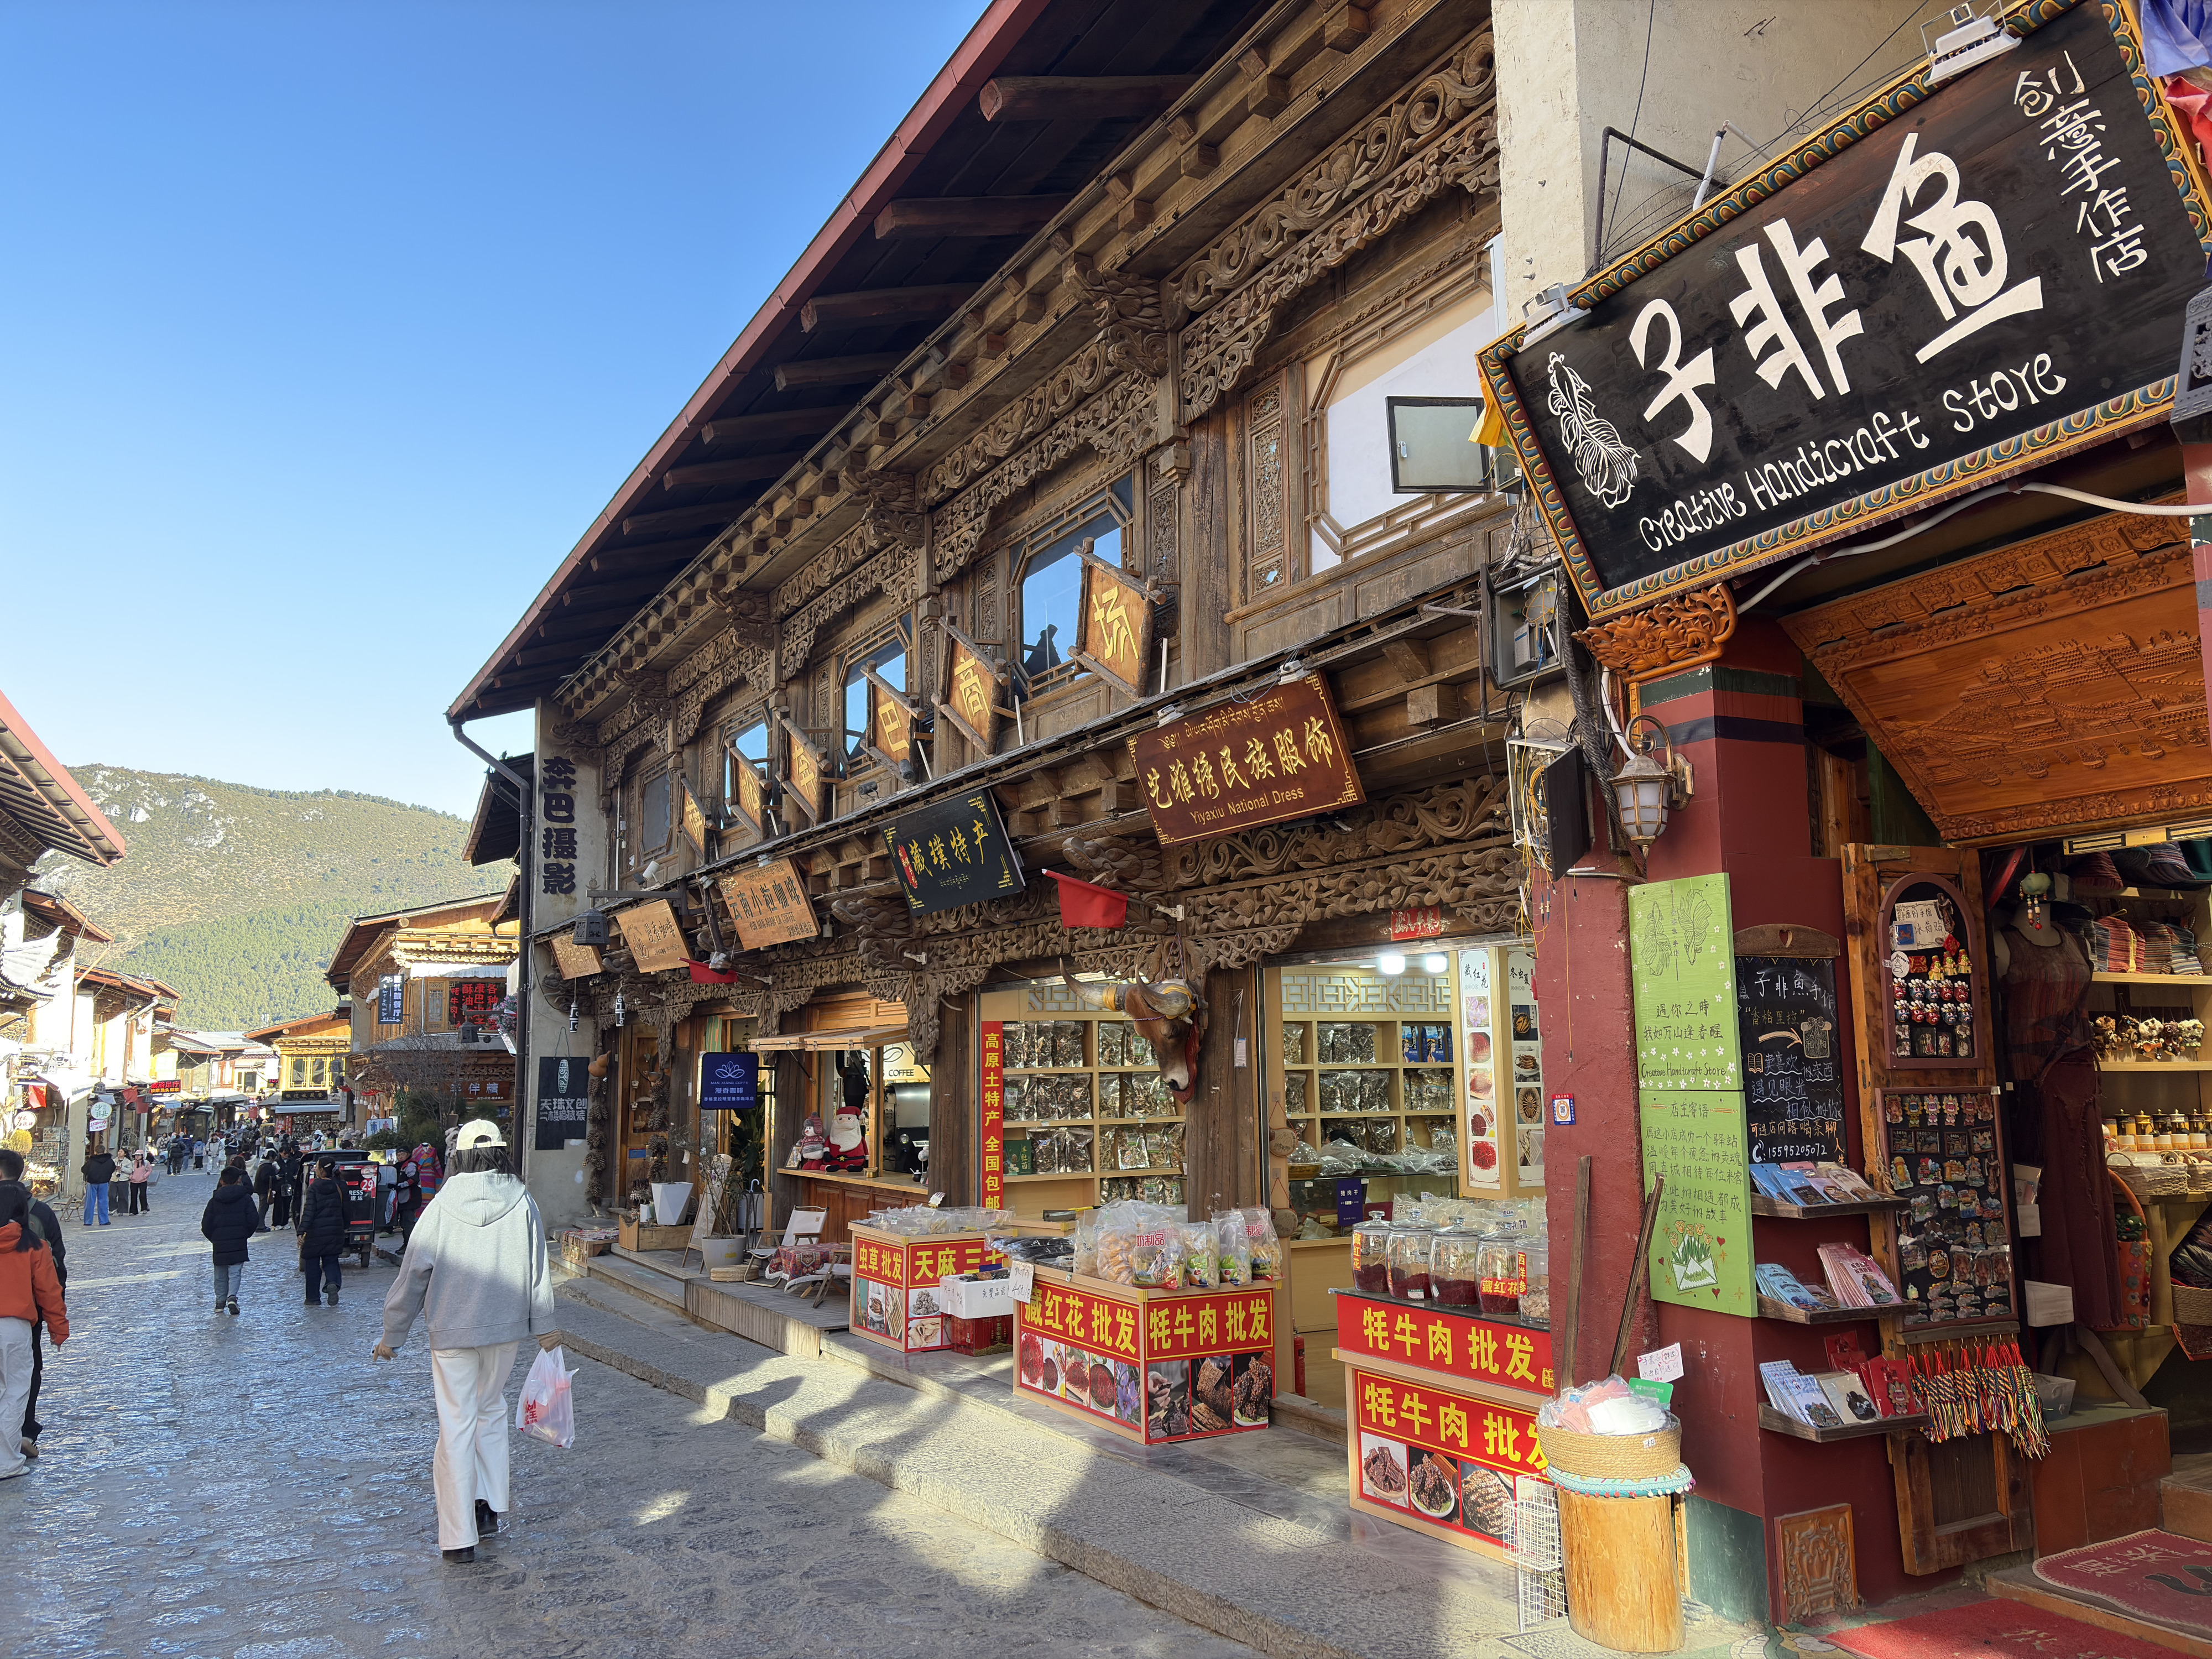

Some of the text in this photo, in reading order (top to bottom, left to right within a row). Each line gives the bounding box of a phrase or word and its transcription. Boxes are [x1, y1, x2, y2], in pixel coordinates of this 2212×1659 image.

[2013, 51, 2147, 284] 创意手作店
[1628, 132, 2044, 465] 子非鱼
[1639, 353, 2067, 552] Creative Handicraft Store
[1092, 585, 1139, 662] 场
[954, 656, 990, 724] 商
[878, 700, 910, 754] 巴
[792, 744, 817, 798] 奔
[1147, 716, 1333, 810] 艺雅绣民族服饰
[1190, 786, 1305, 825] Yiyaxiu National Dress
[542, 755, 577, 895] 奔巴摄影
[727, 876, 801, 921] 云南小粒咖啡
[644, 917, 676, 944] 漫香咖啡
[749, 921, 759, 931] YUN
[756, 919, 766, 929] NAN
[781, 911, 796, 924] COFFEE
[1914, 921, 1942, 935] 冰箱贴
[1464, 963, 1489, 988] 藏红花
[1509, 967, 1531, 986] 冬虫夏
[1641, 1061, 1726, 1083] Creative Handicraft Store
[540, 1098, 587, 1110] 天珠文创
[1669, 1100, 1709, 1119] 店主寄语
[362, 1179, 373, 1191] 29
[1660, 1199, 1728, 1225] 为美好的故事
[1136, 1233, 1165, 1247] 奶制品
[1353, 1233, 1361, 1270] 藏红花
[1481, 1279, 1519, 1295] 藏红花
